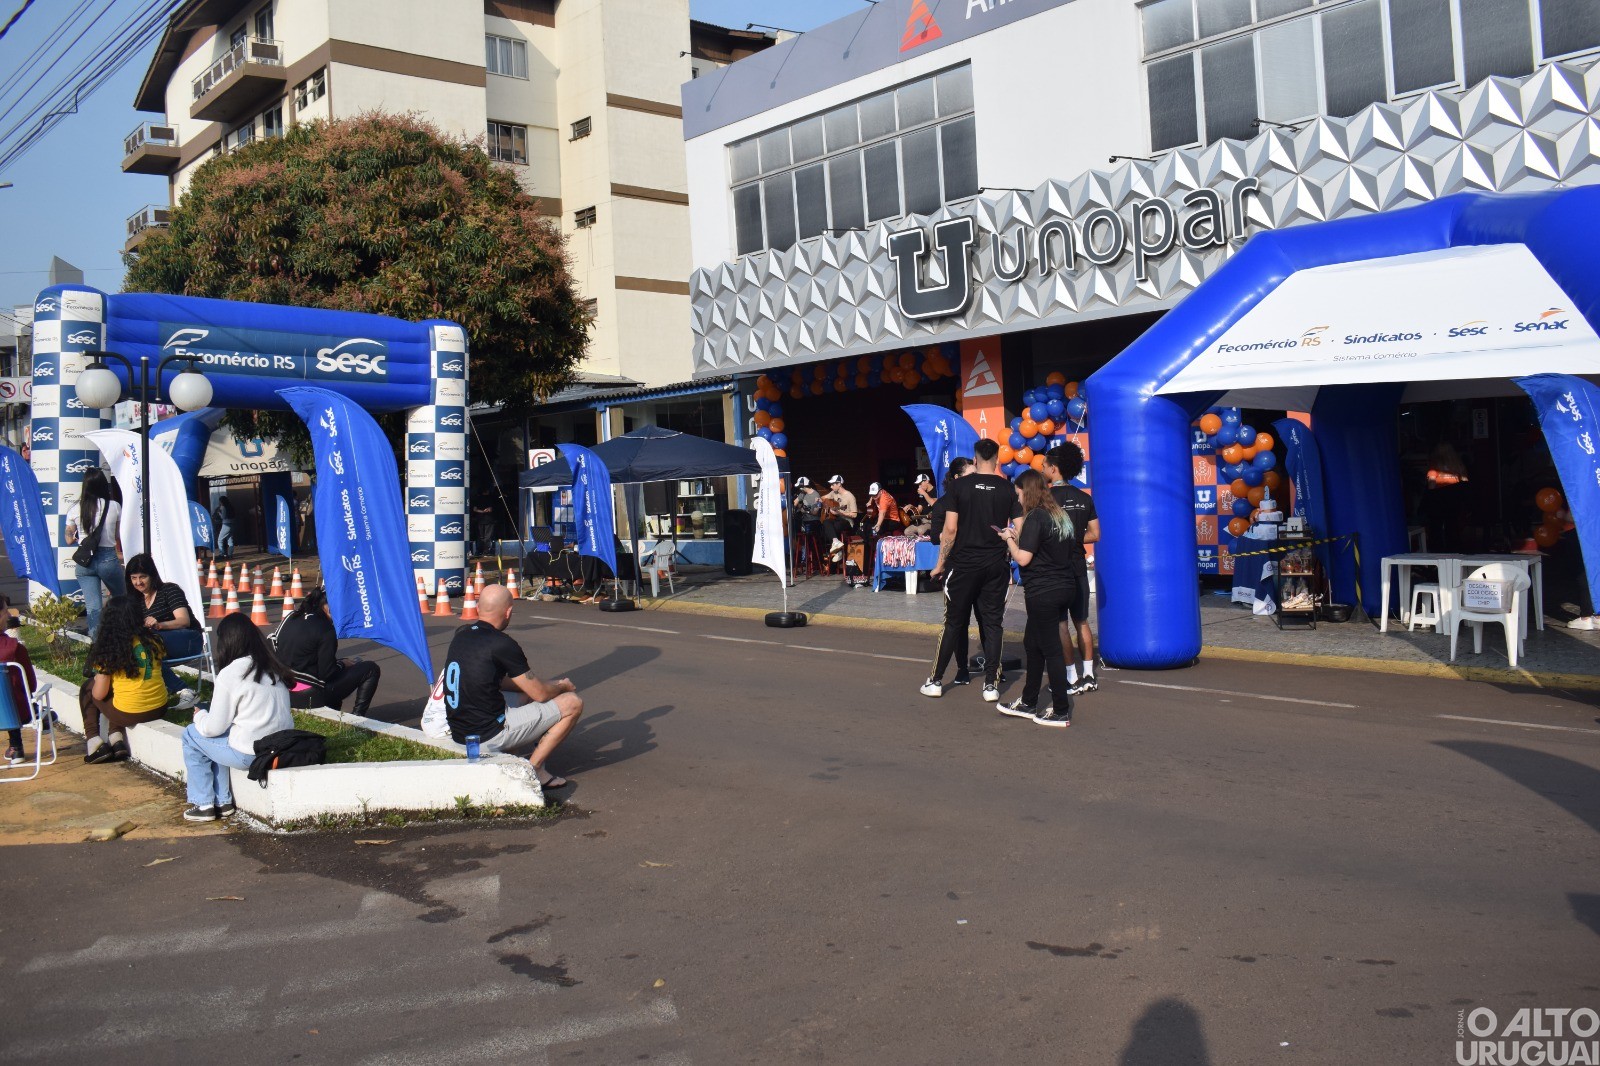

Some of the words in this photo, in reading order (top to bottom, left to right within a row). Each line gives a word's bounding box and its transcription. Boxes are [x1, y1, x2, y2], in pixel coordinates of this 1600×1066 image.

[991, 176, 1260, 282] unopar
[67, 333, 96, 345] Sesc
[1217, 338, 1297, 354] Fecomércio
[1301, 337, 1321, 347] RS
[1343, 332, 1422, 345] Sindicatos
[1448, 326, 1488, 337] Sesc
[1513, 320, 1569, 333] Senac
[273, 355, 296, 370] RS
[316, 348, 386, 375] Sesc
[442, 362, 462, 371] Sesc
[1563, 392, 1582, 421] Senac
[325, 406, 338, 437] Senac
[440, 416, 462, 425] Sesc
[32, 431, 53, 441] Sesc
[1581, 432, 1595, 454] Sesc
[410, 444, 430, 452] Sesc
[230, 461, 282, 471] unopar
[333, 450, 344, 475] Sesc
[440, 471, 462, 479] Sesc
[410, 498, 430, 507] Sesc
[340, 489, 356, 540] Sindicatos
[440, 525, 461, 534] Sesc
[352, 554, 361, 569] RS
[356, 570, 373, 628] Fecomércio
[446, 661, 460, 709] 9
